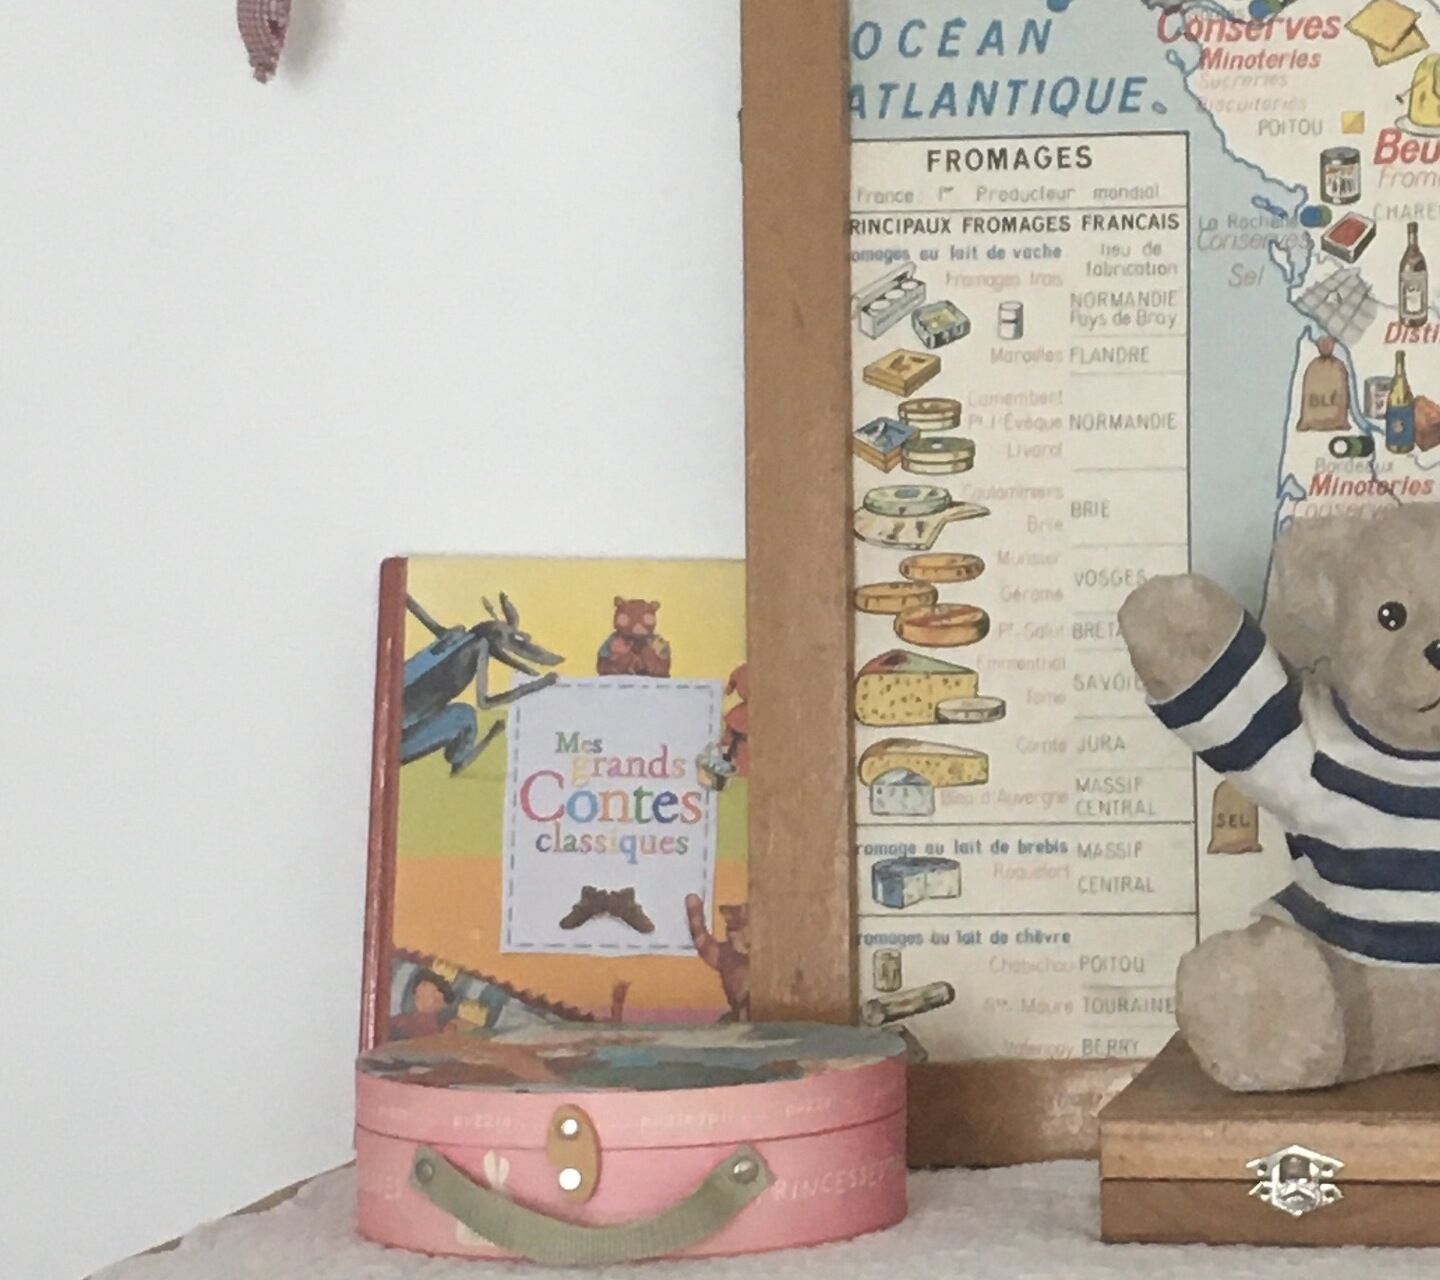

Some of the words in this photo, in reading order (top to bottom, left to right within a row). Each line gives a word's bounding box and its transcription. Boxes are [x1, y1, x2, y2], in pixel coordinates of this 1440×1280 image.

[1157, 10, 1341, 44] Conserves
[1201, 49, 1322, 71] Minoteries
[1258, 119, 1322, 137] POITOU
[926, 145, 1093, 173] FROMAGES
[976, 185, 1075, 203] Producteur
[1093, 183, 1160, 200] mondial
[850, 216, 951, 235] RINCIPAUX
[962, 214, 1071, 233] FROMAGES
[849, 246, 911, 264] omages
[920, 248, 940, 262] au
[950, 243, 979, 262] lait
[987, 245, 1006, 260] de
[1013, 244, 1063, 260] vache
[1086, 260, 1177, 277] fabrication
[1229, 263, 1264, 287] Sel
[1070, 290, 1177, 309] NORMANDIE
[1070, 346, 1150, 364] FLANDRE
[1070, 412, 1177, 431] NORMANDIE
[1308, 474, 1434, 497] Minoteries
[1071, 501, 1111, 519] BRIE
[555, 731, 603, 754] Mes
[1075, 735, 1126, 753] JURA
[571, 746, 685, 786] grands
[1076, 776, 1144, 793] MASSIF
[519, 768, 703, 824] Contes
[1075, 799, 1157, 817] CENTRAL
[1216, 812, 1249, 829] SEL
[535, 826, 689, 864] classiques
[858, 840, 916, 857] romage
[925, 840, 945, 855] au
[954, 838, 982, 855] lait
[991, 839, 1010, 854] de
[1017, 837, 1068, 854] brebis
[1078, 841, 1143, 859] MASSIF
[1078, 874, 1155, 895] CENTRAL
[858, 930, 924, 949] romages
[956, 928, 982, 946] lait
[991, 930, 1009, 945] de
[1016, 926, 1071, 945] chèvre
[1079, 955, 1146, 975] POITOU
[1082, 996, 1175, 1015] TOURAINE
[1081, 1037, 1140, 1058] BERRY
